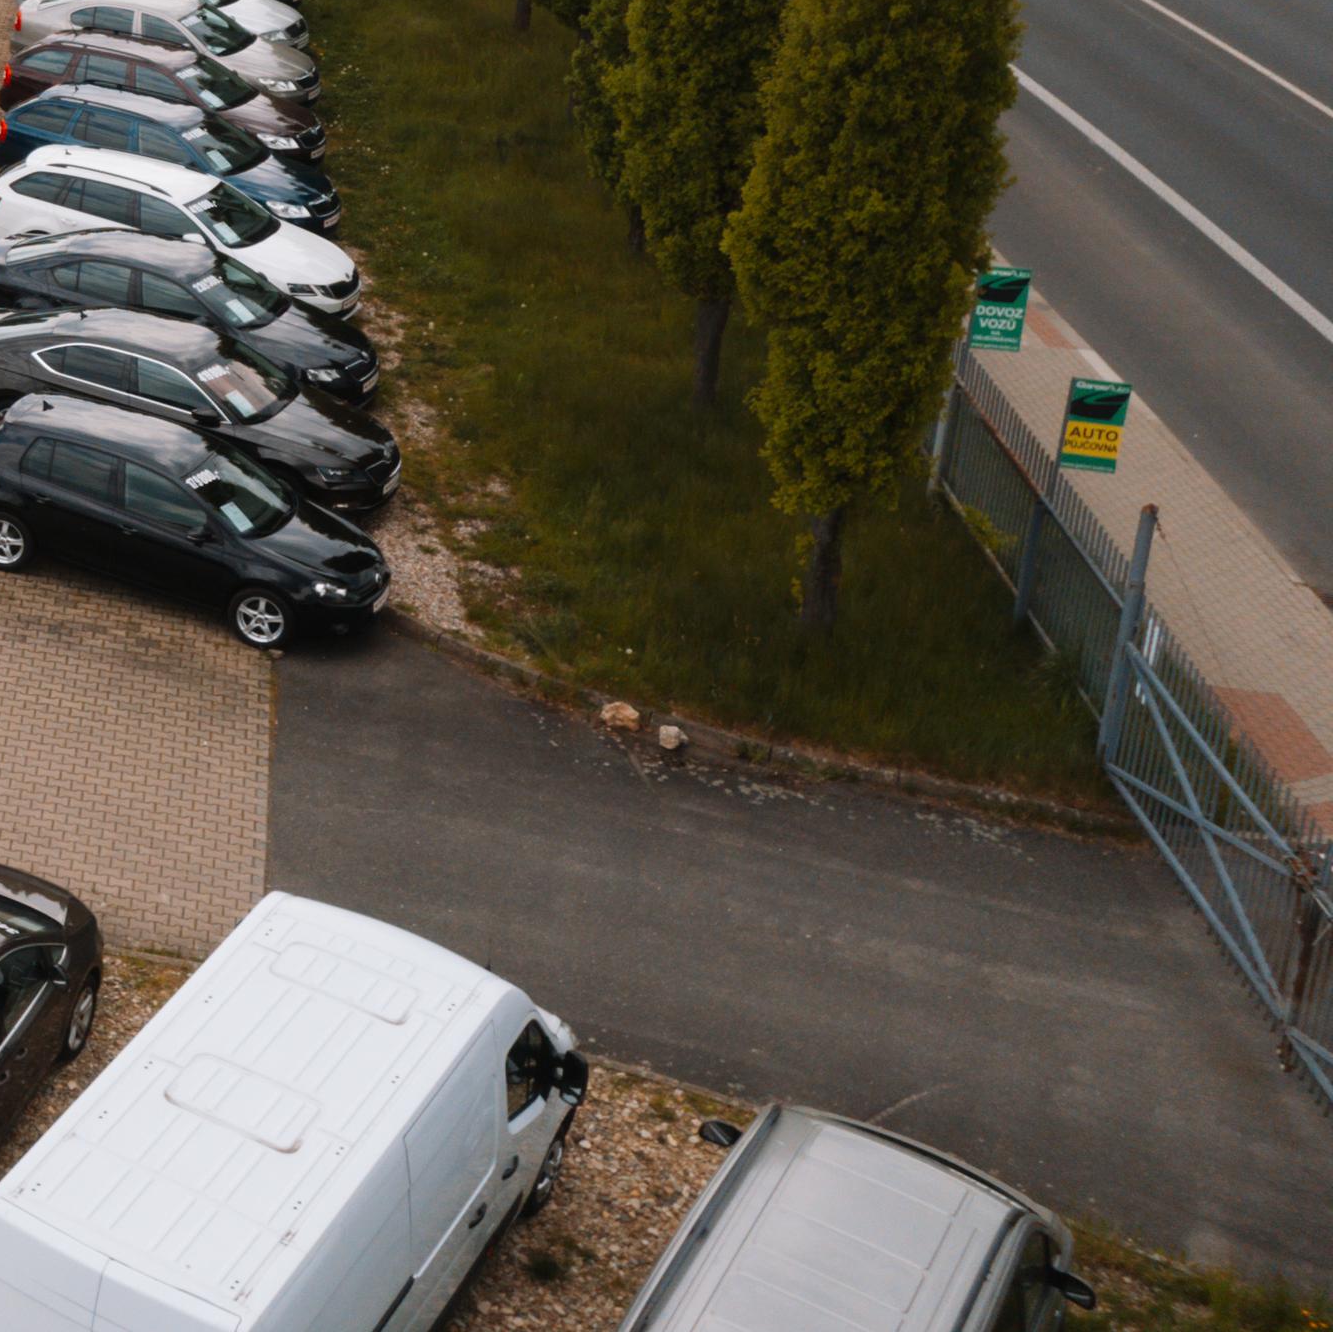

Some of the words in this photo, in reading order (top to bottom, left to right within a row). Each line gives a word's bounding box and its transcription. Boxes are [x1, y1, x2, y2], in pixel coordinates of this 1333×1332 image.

[975, 305, 1023, 319] DOVOZ
[979, 317, 1017, 330] VOZŮ
[1069, 426, 1118, 442] AUTO
